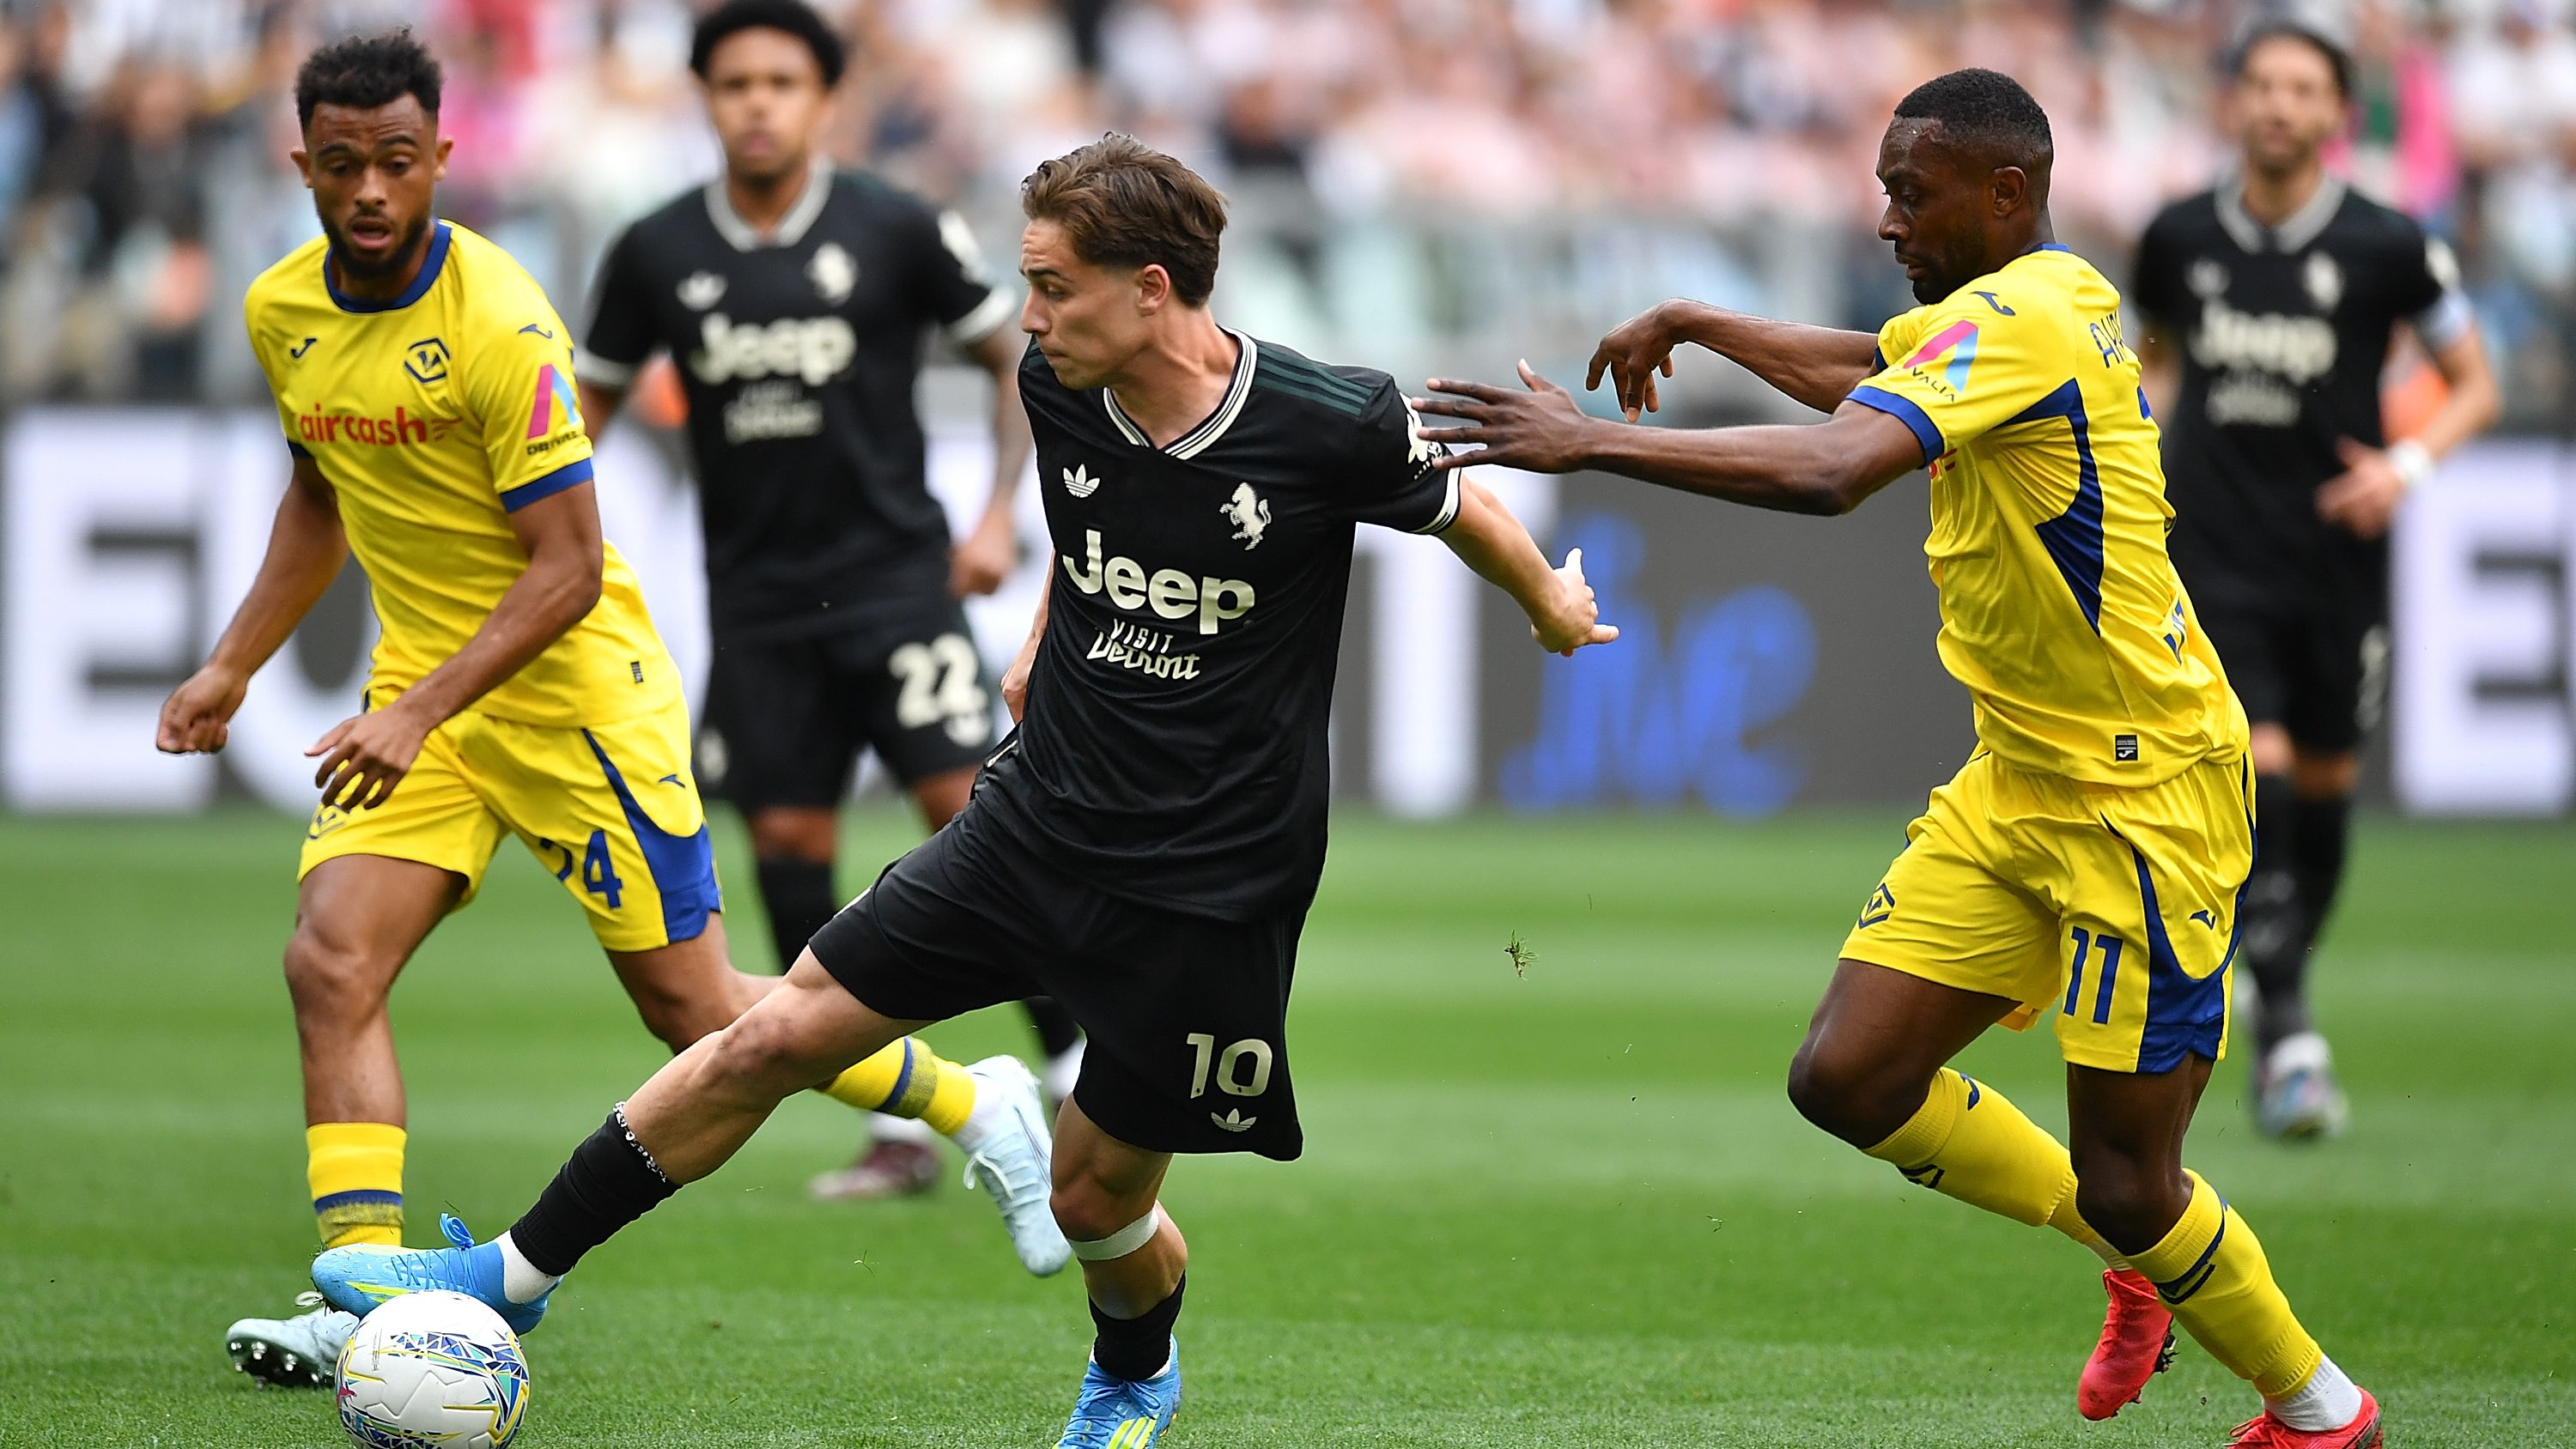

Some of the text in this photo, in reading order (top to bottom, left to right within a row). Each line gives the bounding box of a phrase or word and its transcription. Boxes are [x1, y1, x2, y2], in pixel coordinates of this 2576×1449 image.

[690, 312, 856, 385] Jeep
[301, 403, 427, 446] aircash
[1062, 530, 1255, 635] Jeep
[1086, 630, 1200, 680] Detroit
[1110, 618, 1174, 653] VISIT
[889, 634, 988, 729] 22
[2063, 926, 2123, 1025] 11
[1186, 1033, 1273, 1099] 10
